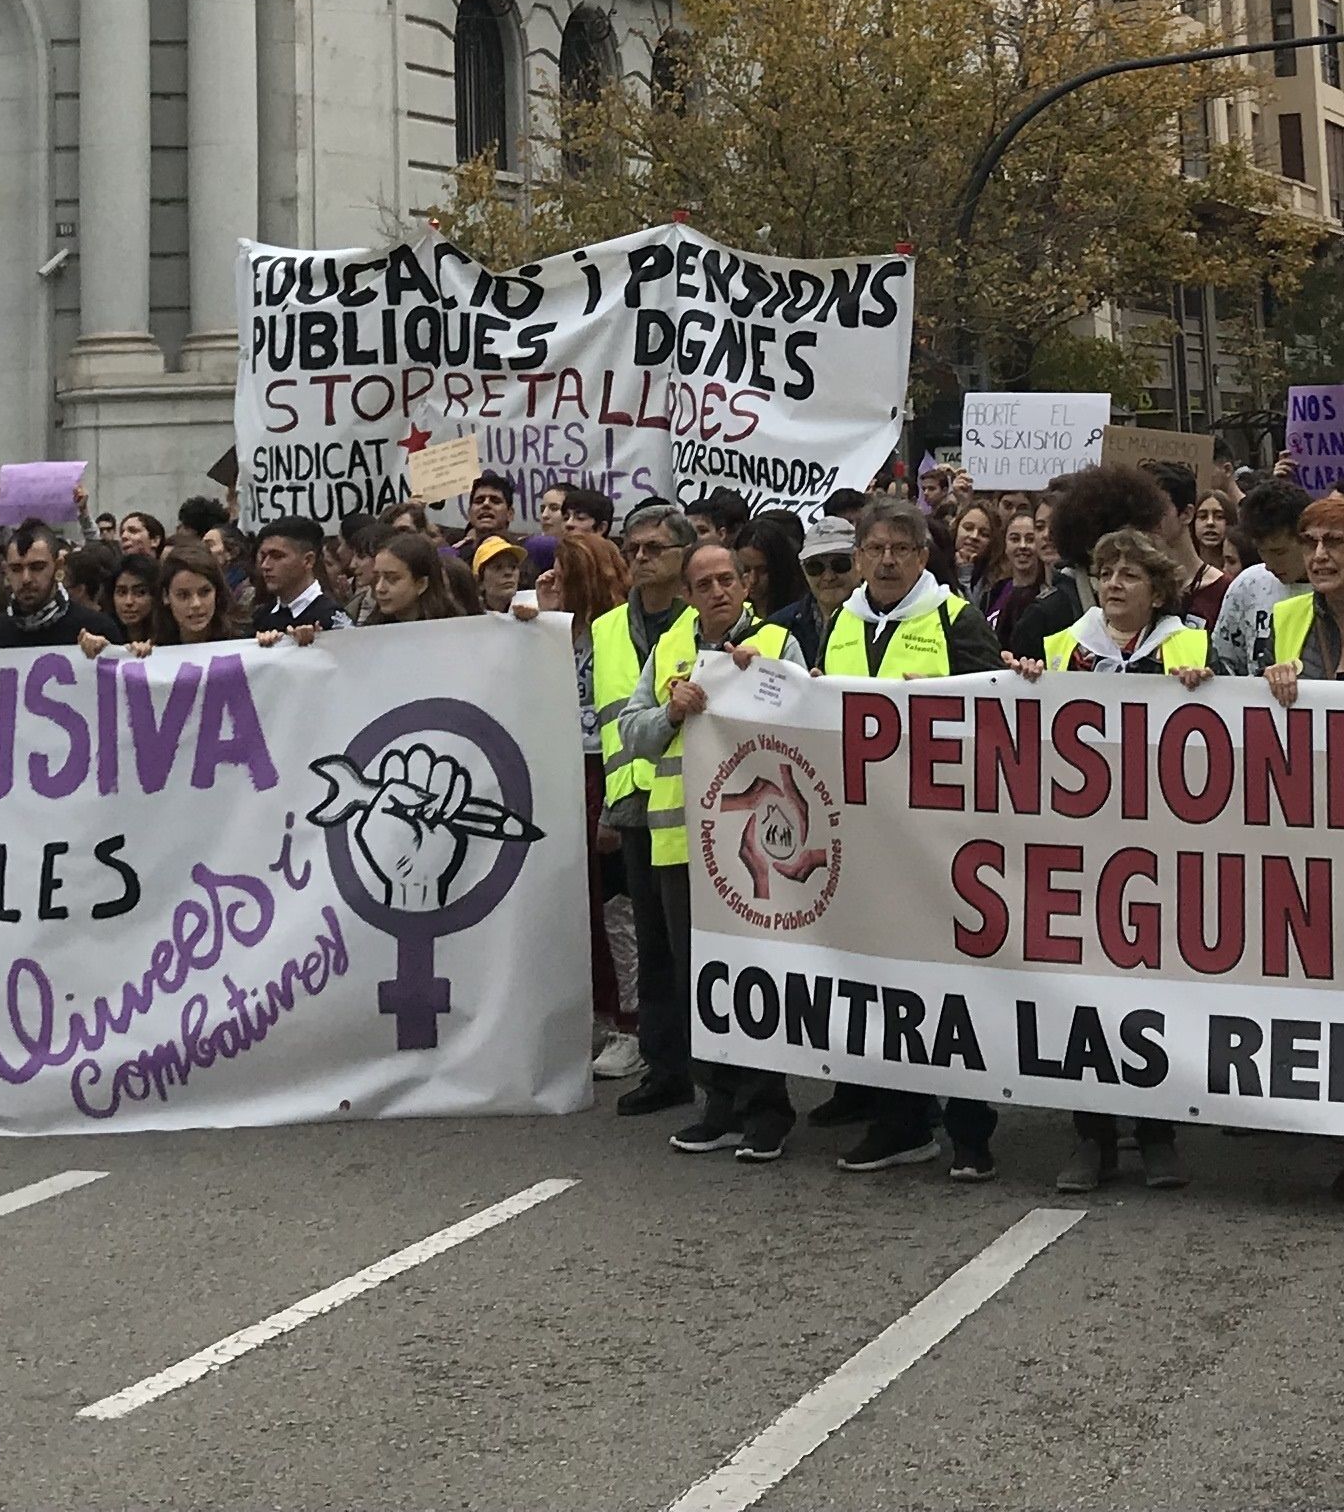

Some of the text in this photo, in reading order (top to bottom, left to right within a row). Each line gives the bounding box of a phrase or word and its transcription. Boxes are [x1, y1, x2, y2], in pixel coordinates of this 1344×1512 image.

[573, 250, 603, 316] i
[624, 241, 906, 329] PENSIONS
[252, 302, 817, 401] PÚBLIQUES DGNES
[966, 400, 1075, 426] ABORTÉ EL
[991, 430, 1072, 450] SEXISMO
[1292, 395, 1336, 421] NOS
[253, 438, 389, 484] SINDICAT
[457, 422, 588, 468] IURES
[672, 439, 839, 497] OORDINADORA
[968, 456, 988, 476] EN
[996, 456, 1010, 475] LA
[700, 734, 841, 828] Coordinadora Valenciana por la
[269, 813, 313, 891] i
[700, 819, 842, 931] Defensa del Sistema Público de Pensiones
[951, 838, 1334, 981] SEGUN
[695, 960, 987, 1072] CONTRA
[1016, 999, 1170, 1088] LAS
